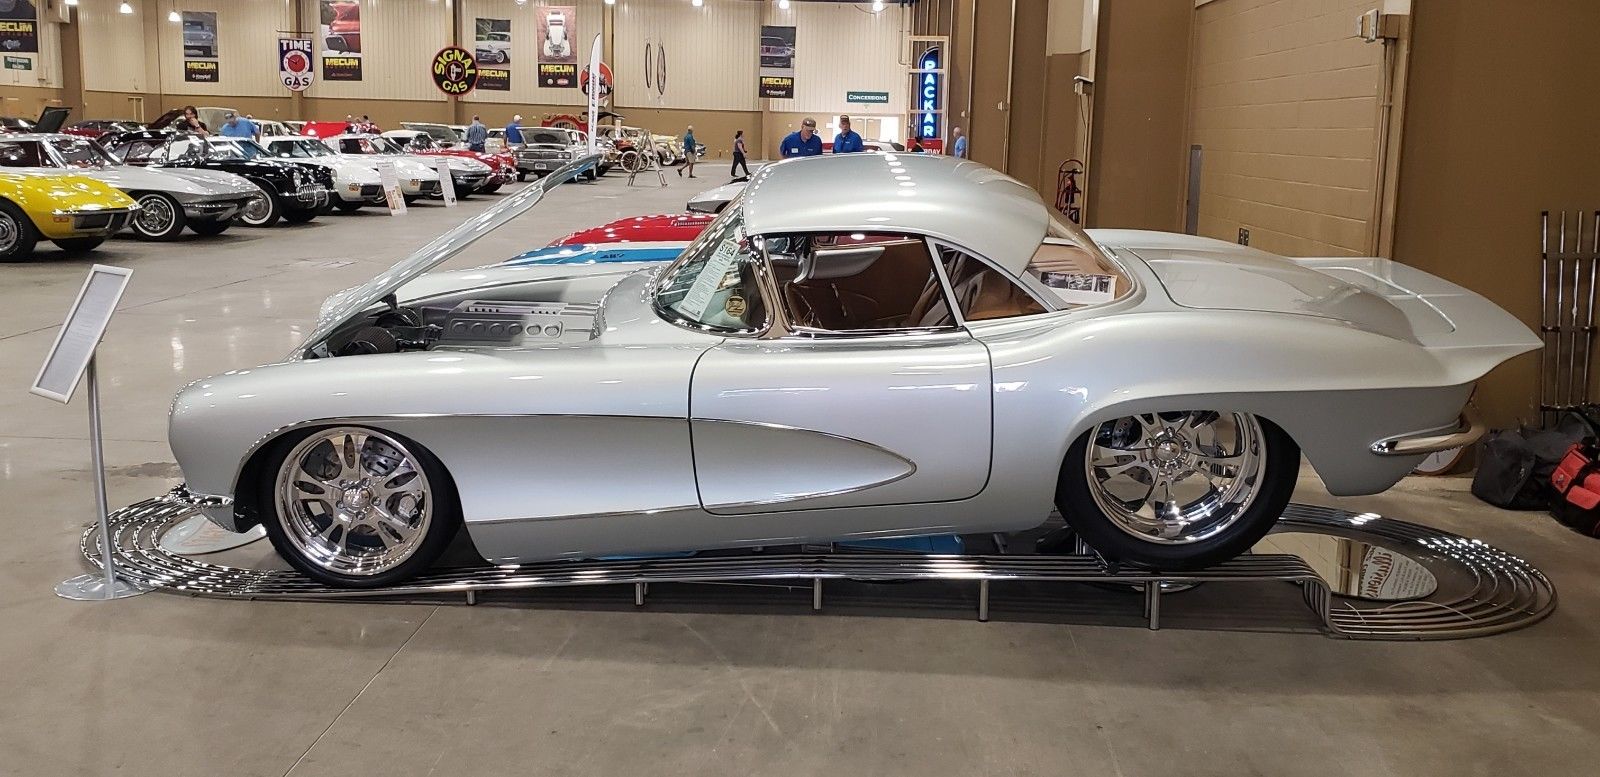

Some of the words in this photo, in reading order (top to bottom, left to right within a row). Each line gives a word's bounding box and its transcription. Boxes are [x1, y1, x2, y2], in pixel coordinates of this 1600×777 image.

[0, 22, 32, 32] ECUM
[281, 40, 311, 52] TIME
[325, 58, 359, 66] MECUM
[434, 50, 475, 78] SIGNAL
[478, 69, 508, 77] MECUM
[541, 64, 575, 73] MECUM
[284, 77, 310, 86] GAS
[762, 77, 792, 86] MECUM
[442, 80, 468, 93] GAS
[923, 60, 936, 137] PACKAR
